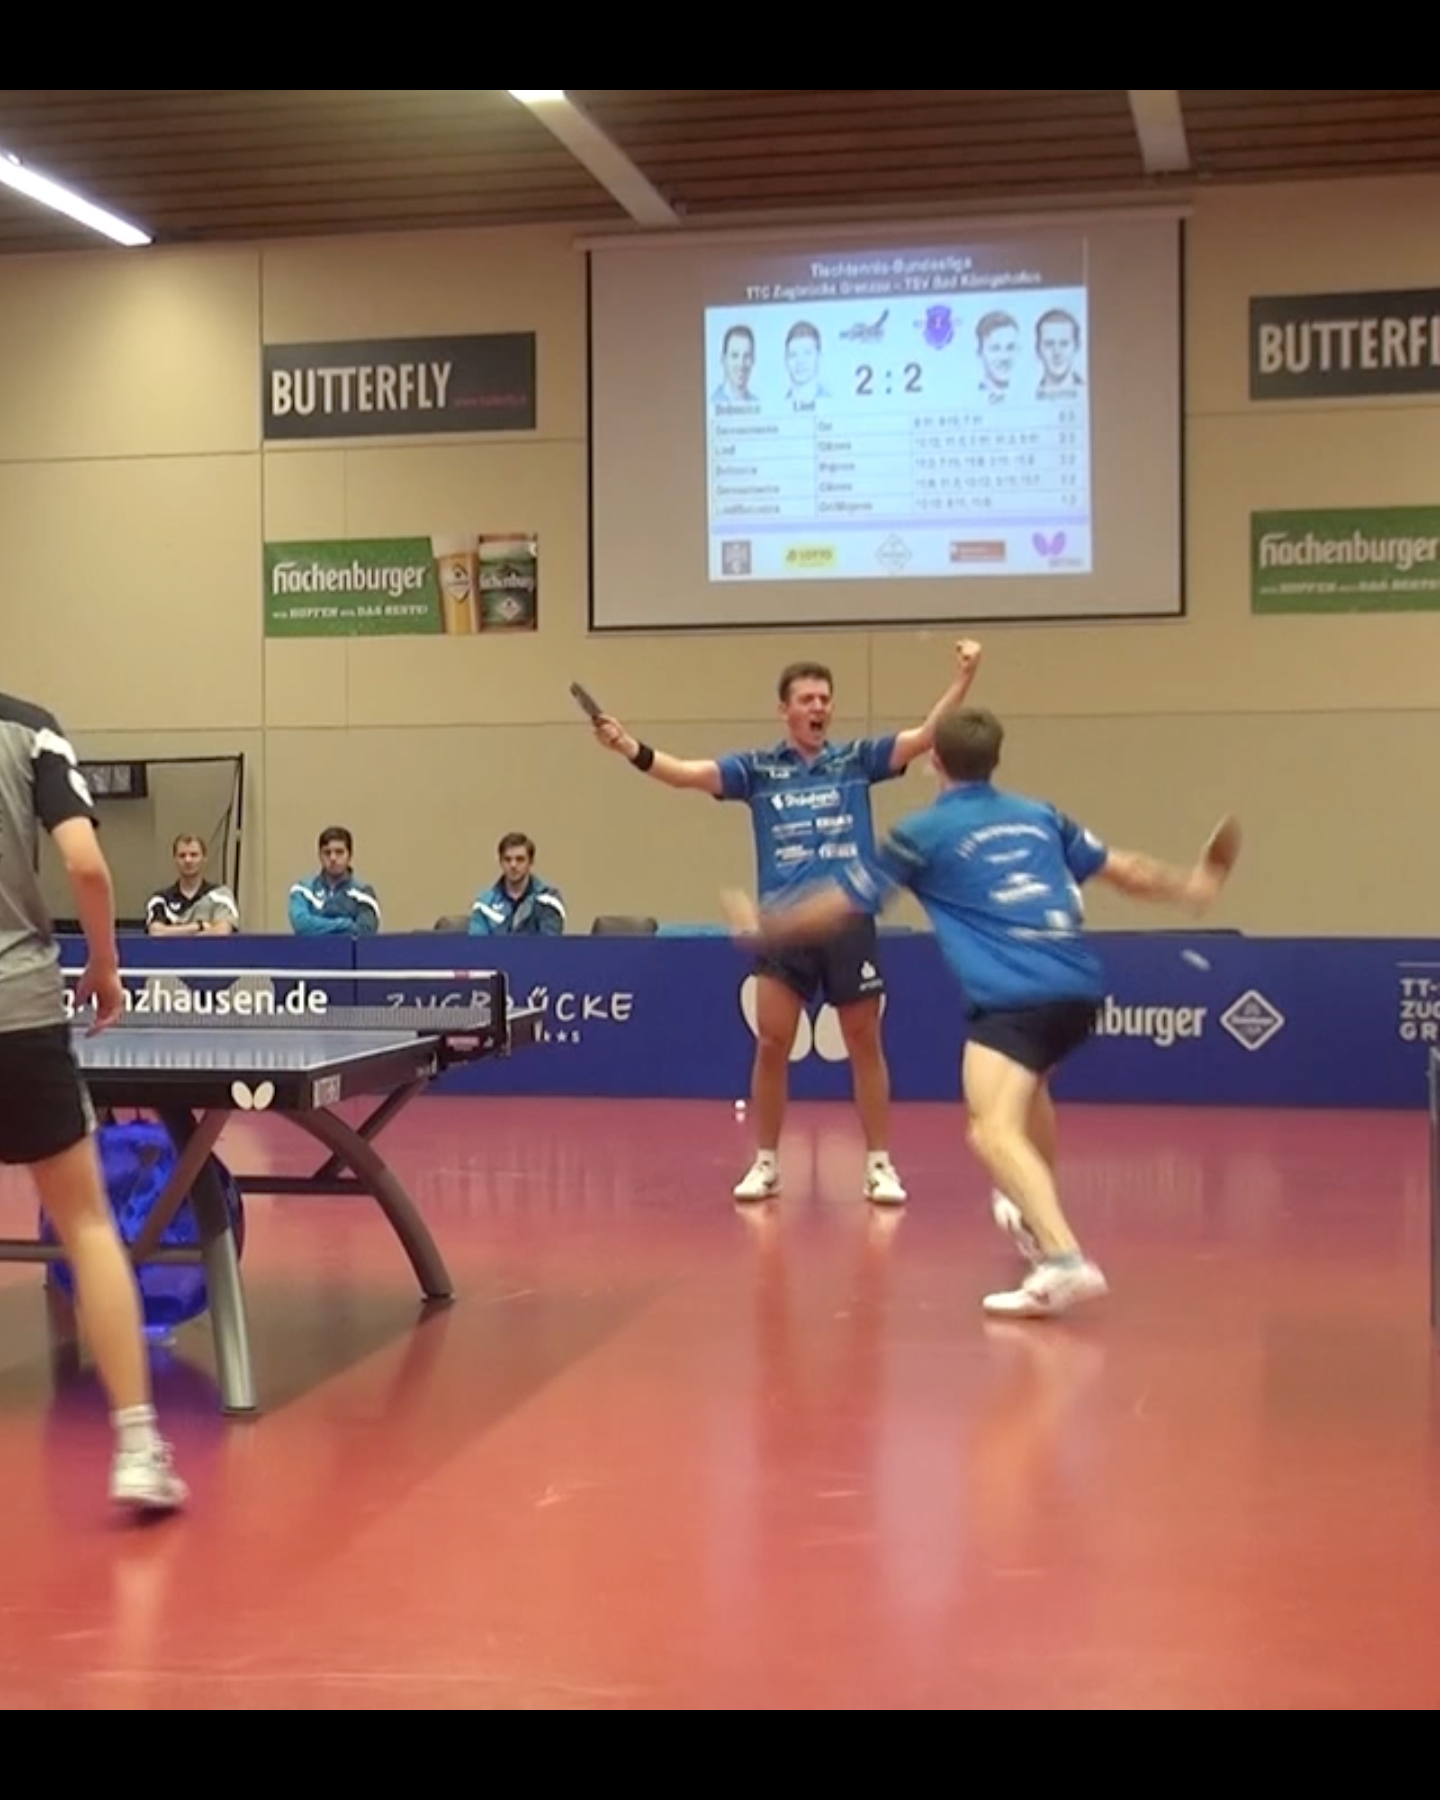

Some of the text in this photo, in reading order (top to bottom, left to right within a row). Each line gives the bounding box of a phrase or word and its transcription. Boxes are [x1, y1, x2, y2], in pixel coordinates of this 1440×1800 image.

[271, 361, 452, 415] BUTTERFLY
[855, 364, 873, 395] 2
[904, 362, 923, 392] 2
[1399, 978, 1440, 997] TT-
